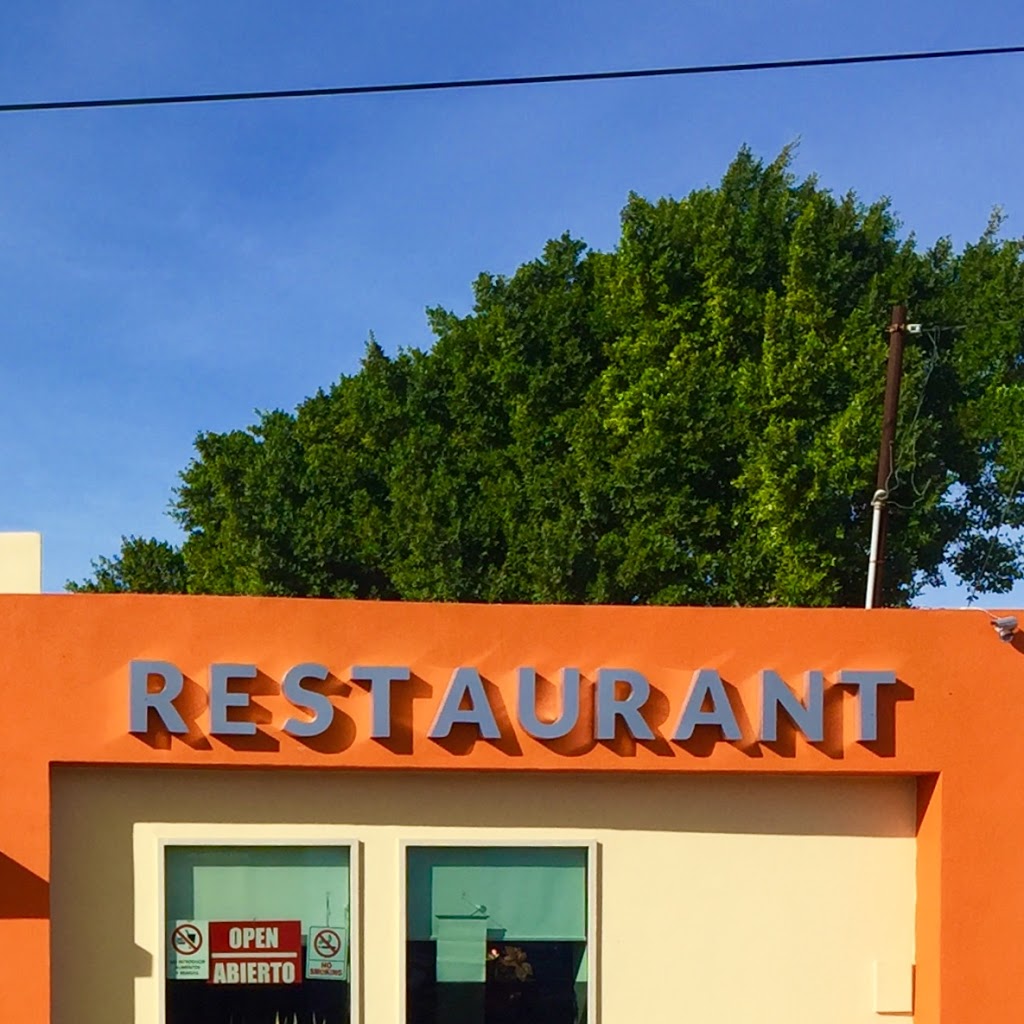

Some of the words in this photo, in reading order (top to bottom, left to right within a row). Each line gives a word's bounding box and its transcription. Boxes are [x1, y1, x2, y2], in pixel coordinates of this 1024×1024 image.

[129, 660, 896, 743] RESTAURANT
[228, 927, 279, 949] OPEN
[213, 962, 296, 984] ABIERTO
